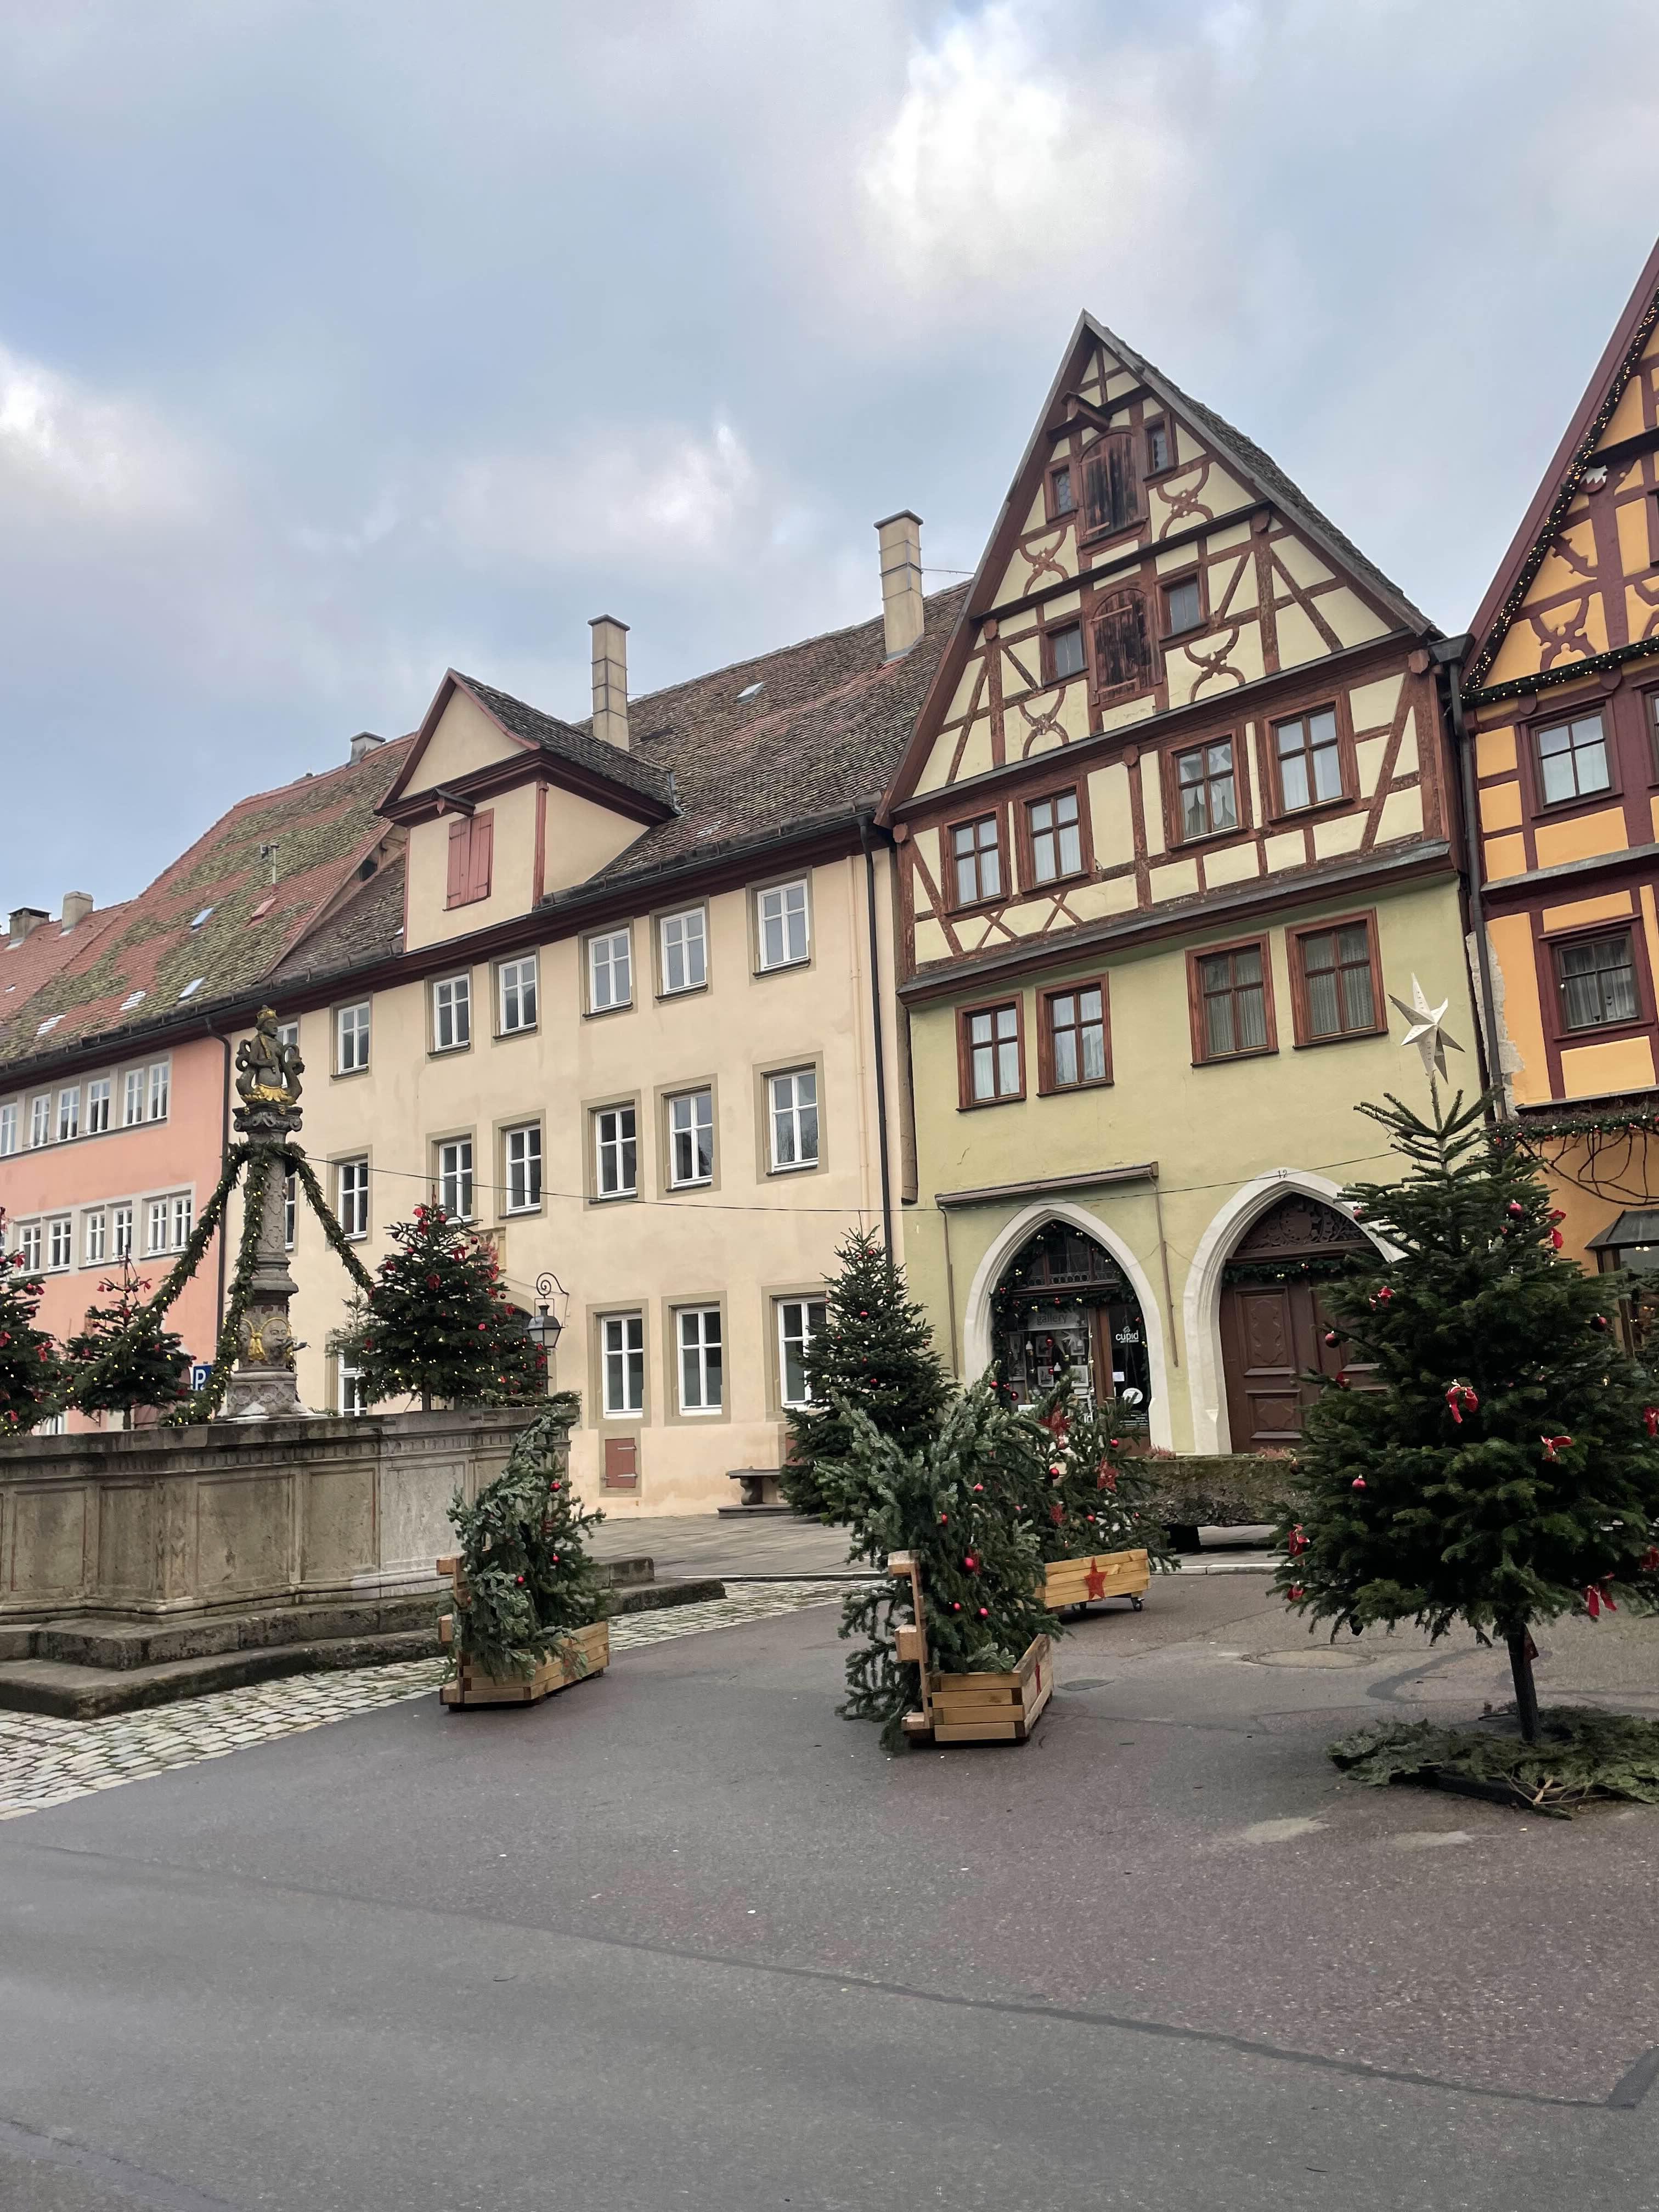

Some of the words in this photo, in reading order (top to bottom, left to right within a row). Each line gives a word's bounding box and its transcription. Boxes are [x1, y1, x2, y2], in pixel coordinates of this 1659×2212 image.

[1278, 1170, 1288, 1178] 12
[1037, 1313, 1067, 1325] gallery
[1115, 1330, 1139, 1343] cupid
[195, 1369, 206, 1391] P
